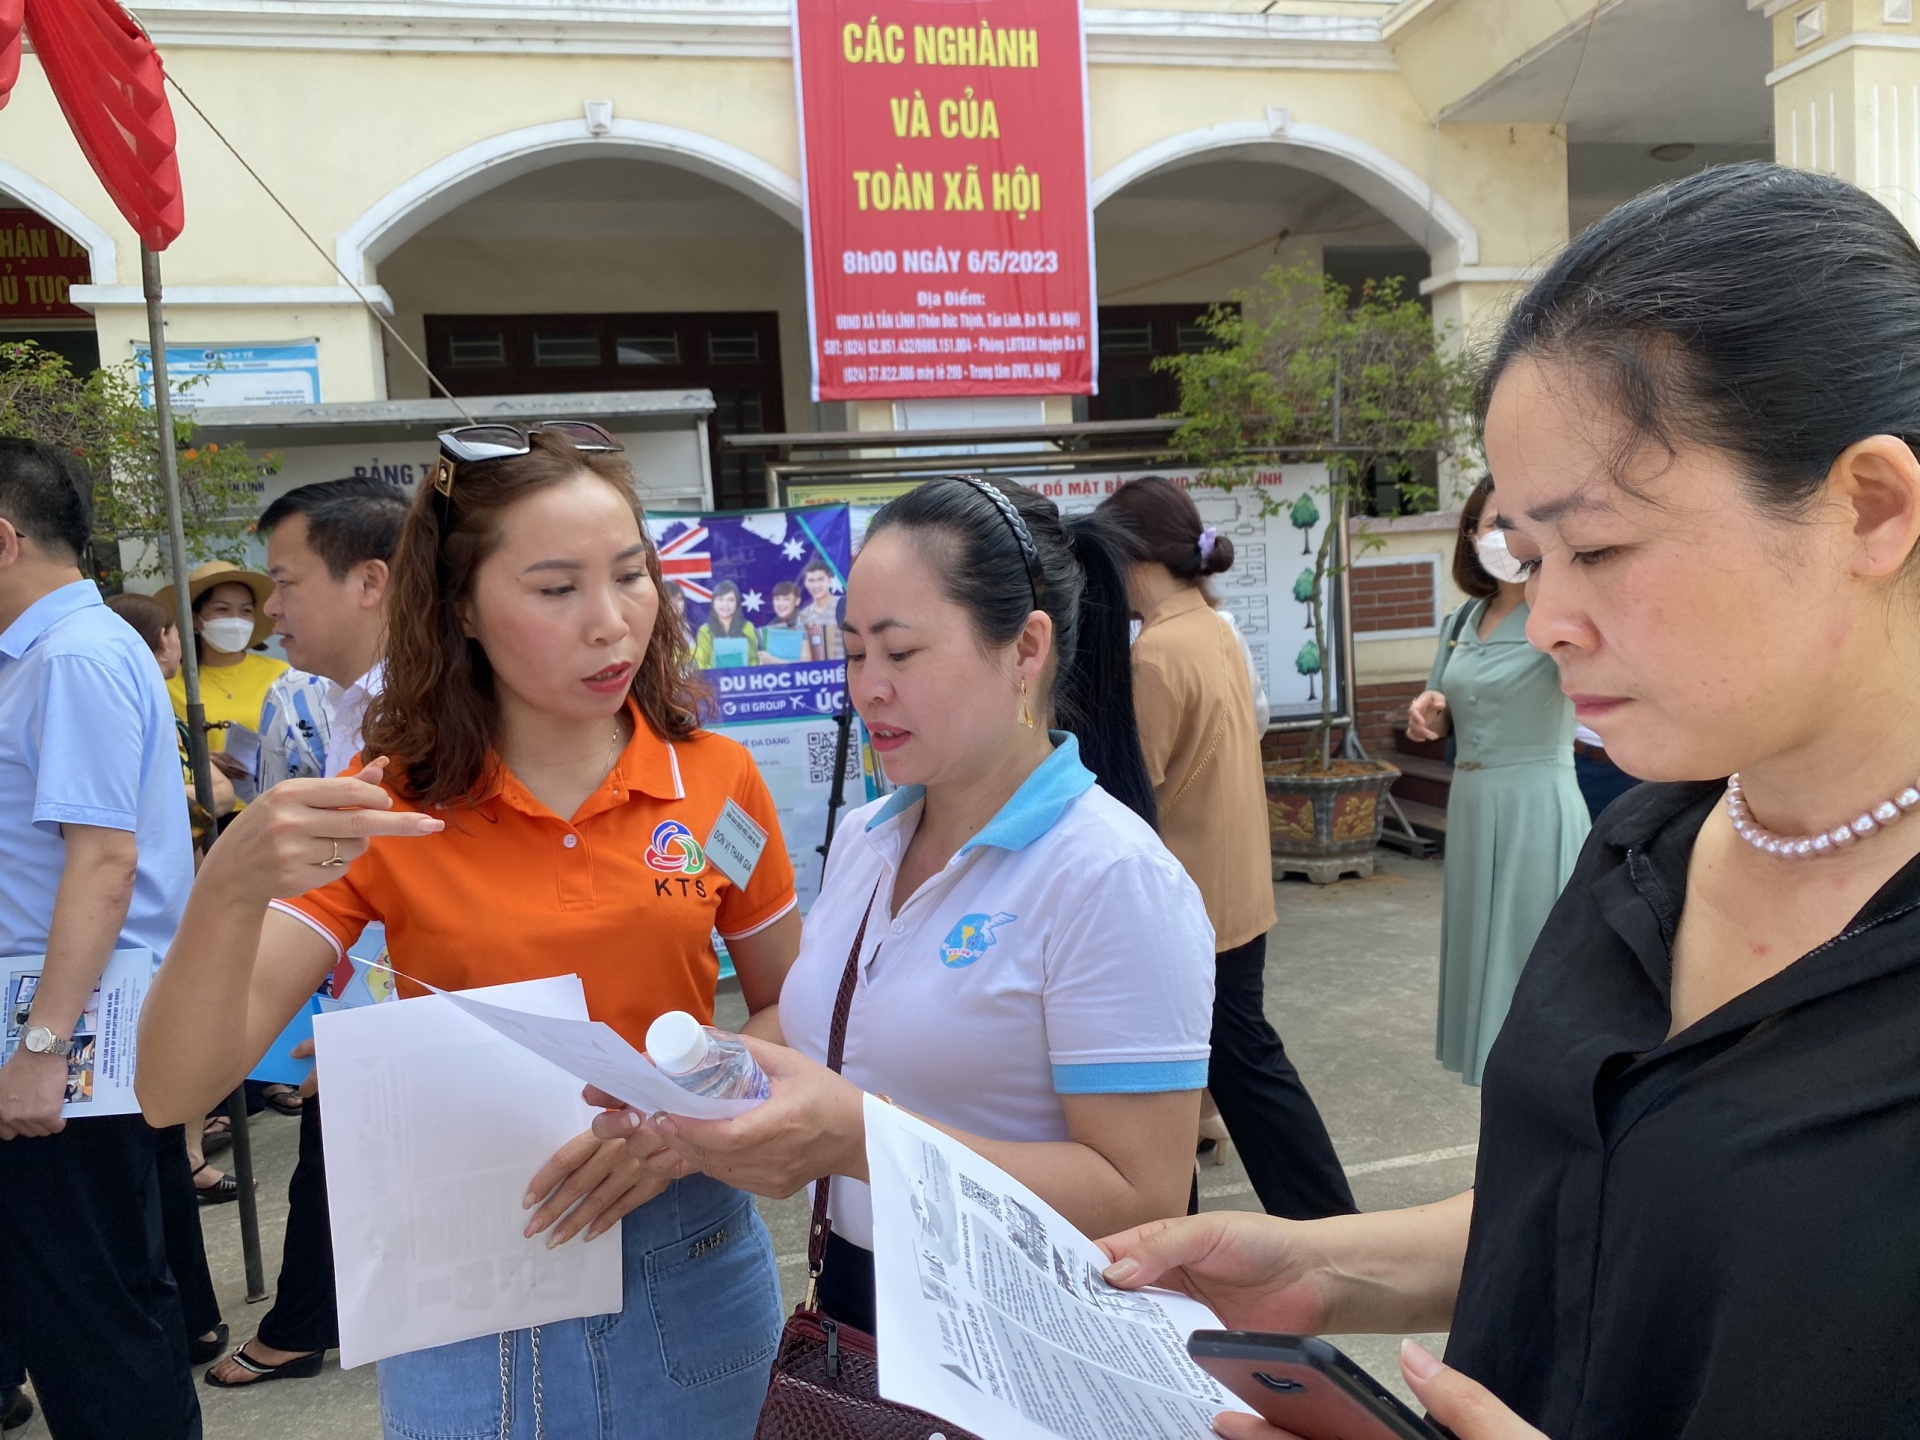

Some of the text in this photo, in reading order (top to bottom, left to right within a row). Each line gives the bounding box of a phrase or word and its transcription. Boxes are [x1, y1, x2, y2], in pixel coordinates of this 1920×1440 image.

[842, 15, 1039, 67] CÁC NGHÀNH
[889, 86, 1000, 139] VÀ CỦA
[853, 162, 1041, 219] TOÀN XÃ HỘI
[842, 246, 1058, 274] 8h00 NGÀY 6/5/2023
[0, 263, 69, 311] Ủ TỤC
[917, 288, 986, 309] Địa Điểm:
[354, 457, 414, 485] BẢNG
[1043, 479, 1063, 496] ĐỒ
[1068, 479, 1099, 498] MẶT
[719, 675, 747, 693] DU
[750, 672, 792, 693] HỌC
[752, 700, 786, 713] GROUP
[766, 736, 790, 749] DẠNG
[714, 830, 752, 873] ĐƠN VỊ THAM GIA
[654, 878, 707, 898] KTS
[985, 1364, 1004, 1400] THÔNG
